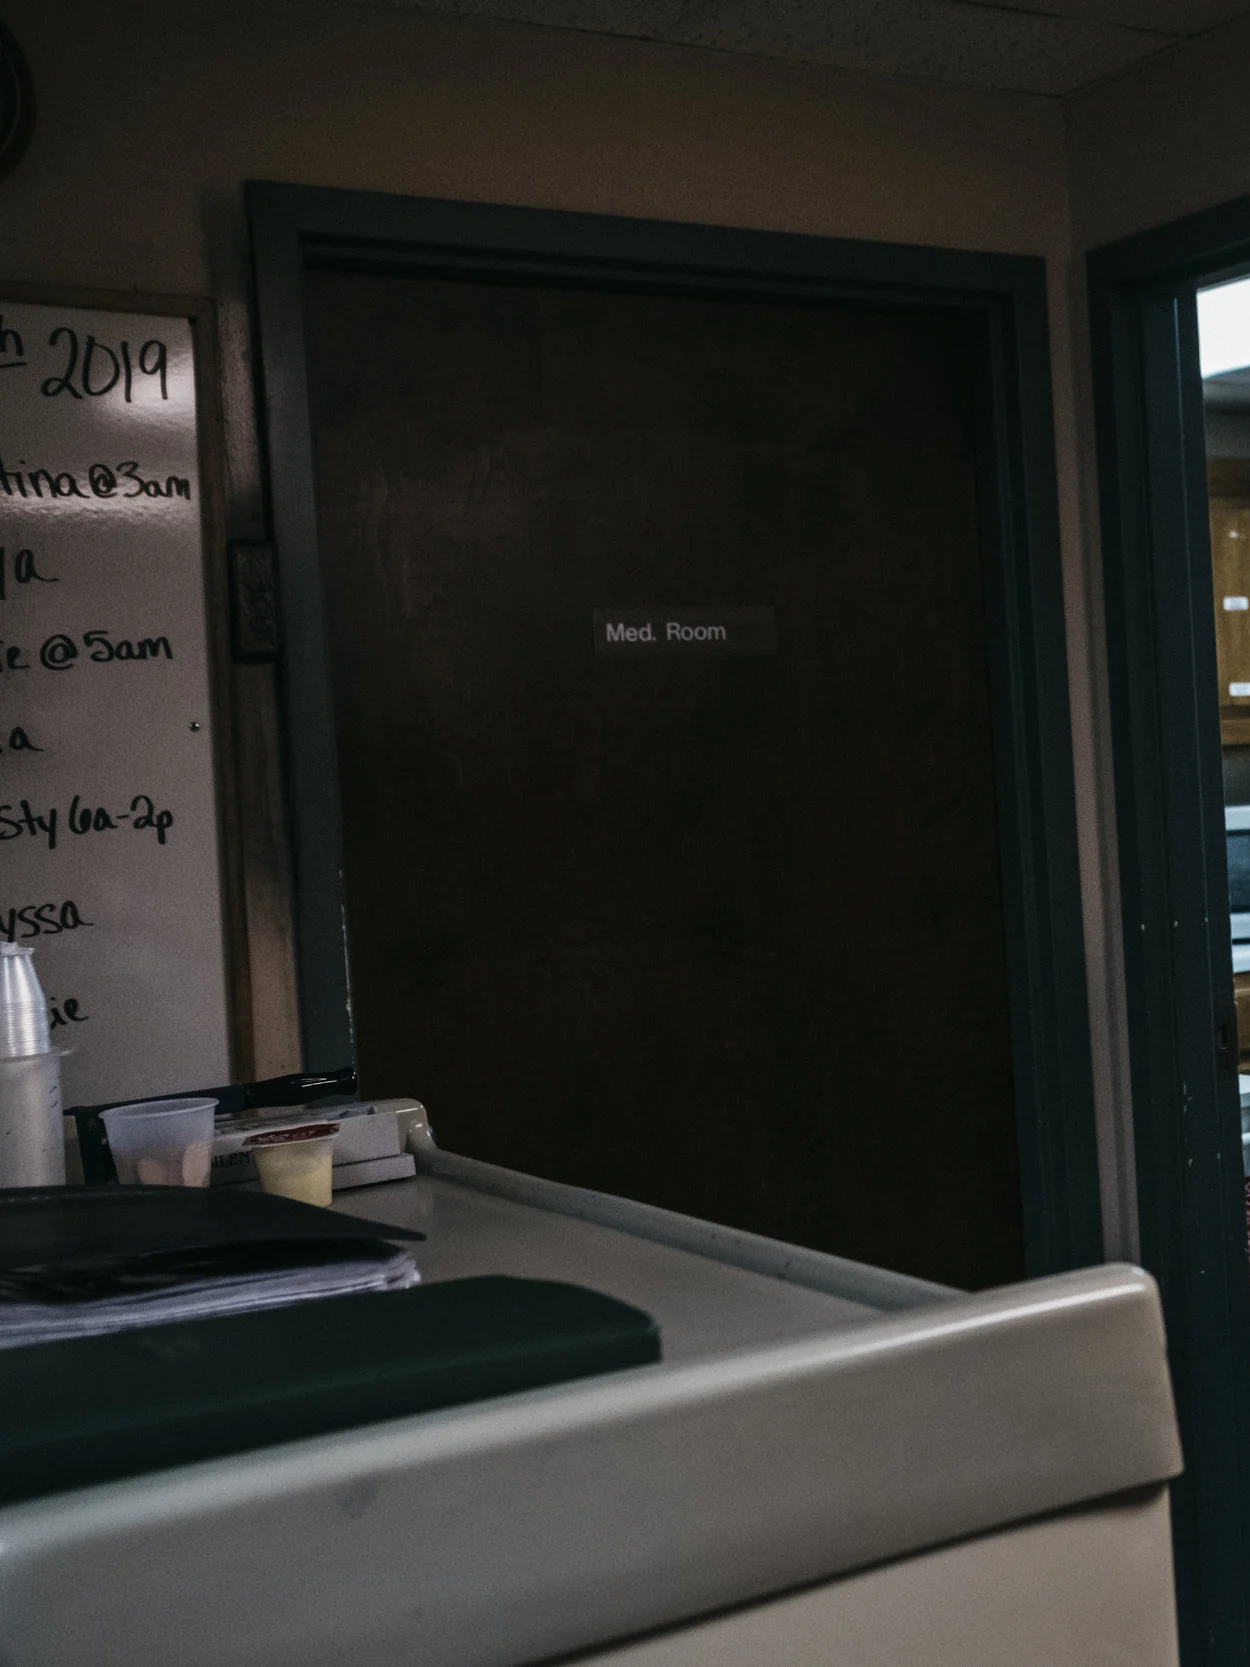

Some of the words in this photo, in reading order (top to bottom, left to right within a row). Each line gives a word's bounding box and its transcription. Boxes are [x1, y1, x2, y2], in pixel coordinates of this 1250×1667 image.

[40, 326, 168, 403] 2019
[606, 622, 657, 642] Med.
[666, 622, 727, 641] Room
